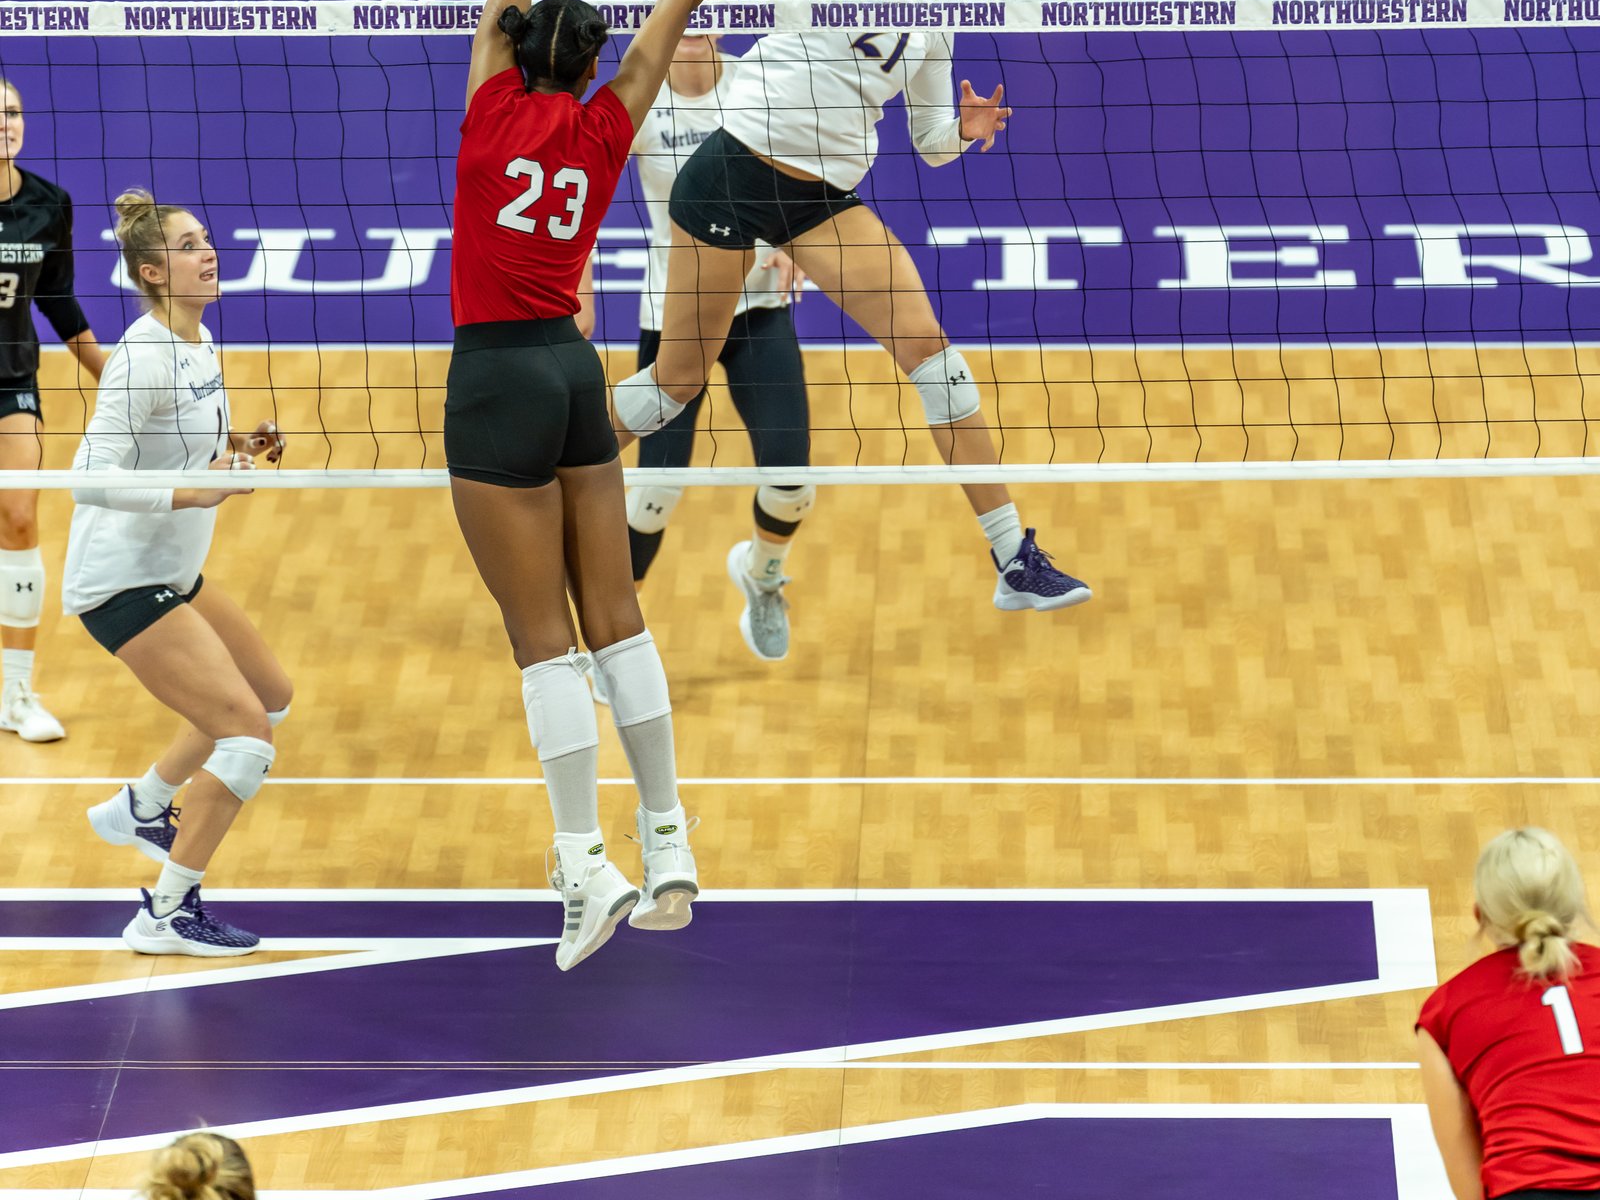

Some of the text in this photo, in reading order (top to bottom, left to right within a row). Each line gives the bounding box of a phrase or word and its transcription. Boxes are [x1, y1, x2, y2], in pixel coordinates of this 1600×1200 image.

[124, 6, 317, 30] NORTHWESTERN
[353, 5, 483, 29] NORTHWES
[811, 3, 1005, 27] NORTHWESTERN
[1041, 1, 1236, 26] NORTHWESTERN
[1272, 0, 1468, 24] NORTHWESTERN
[496, 155, 589, 240] 23
[1541, 985, 1585, 1056] 1
